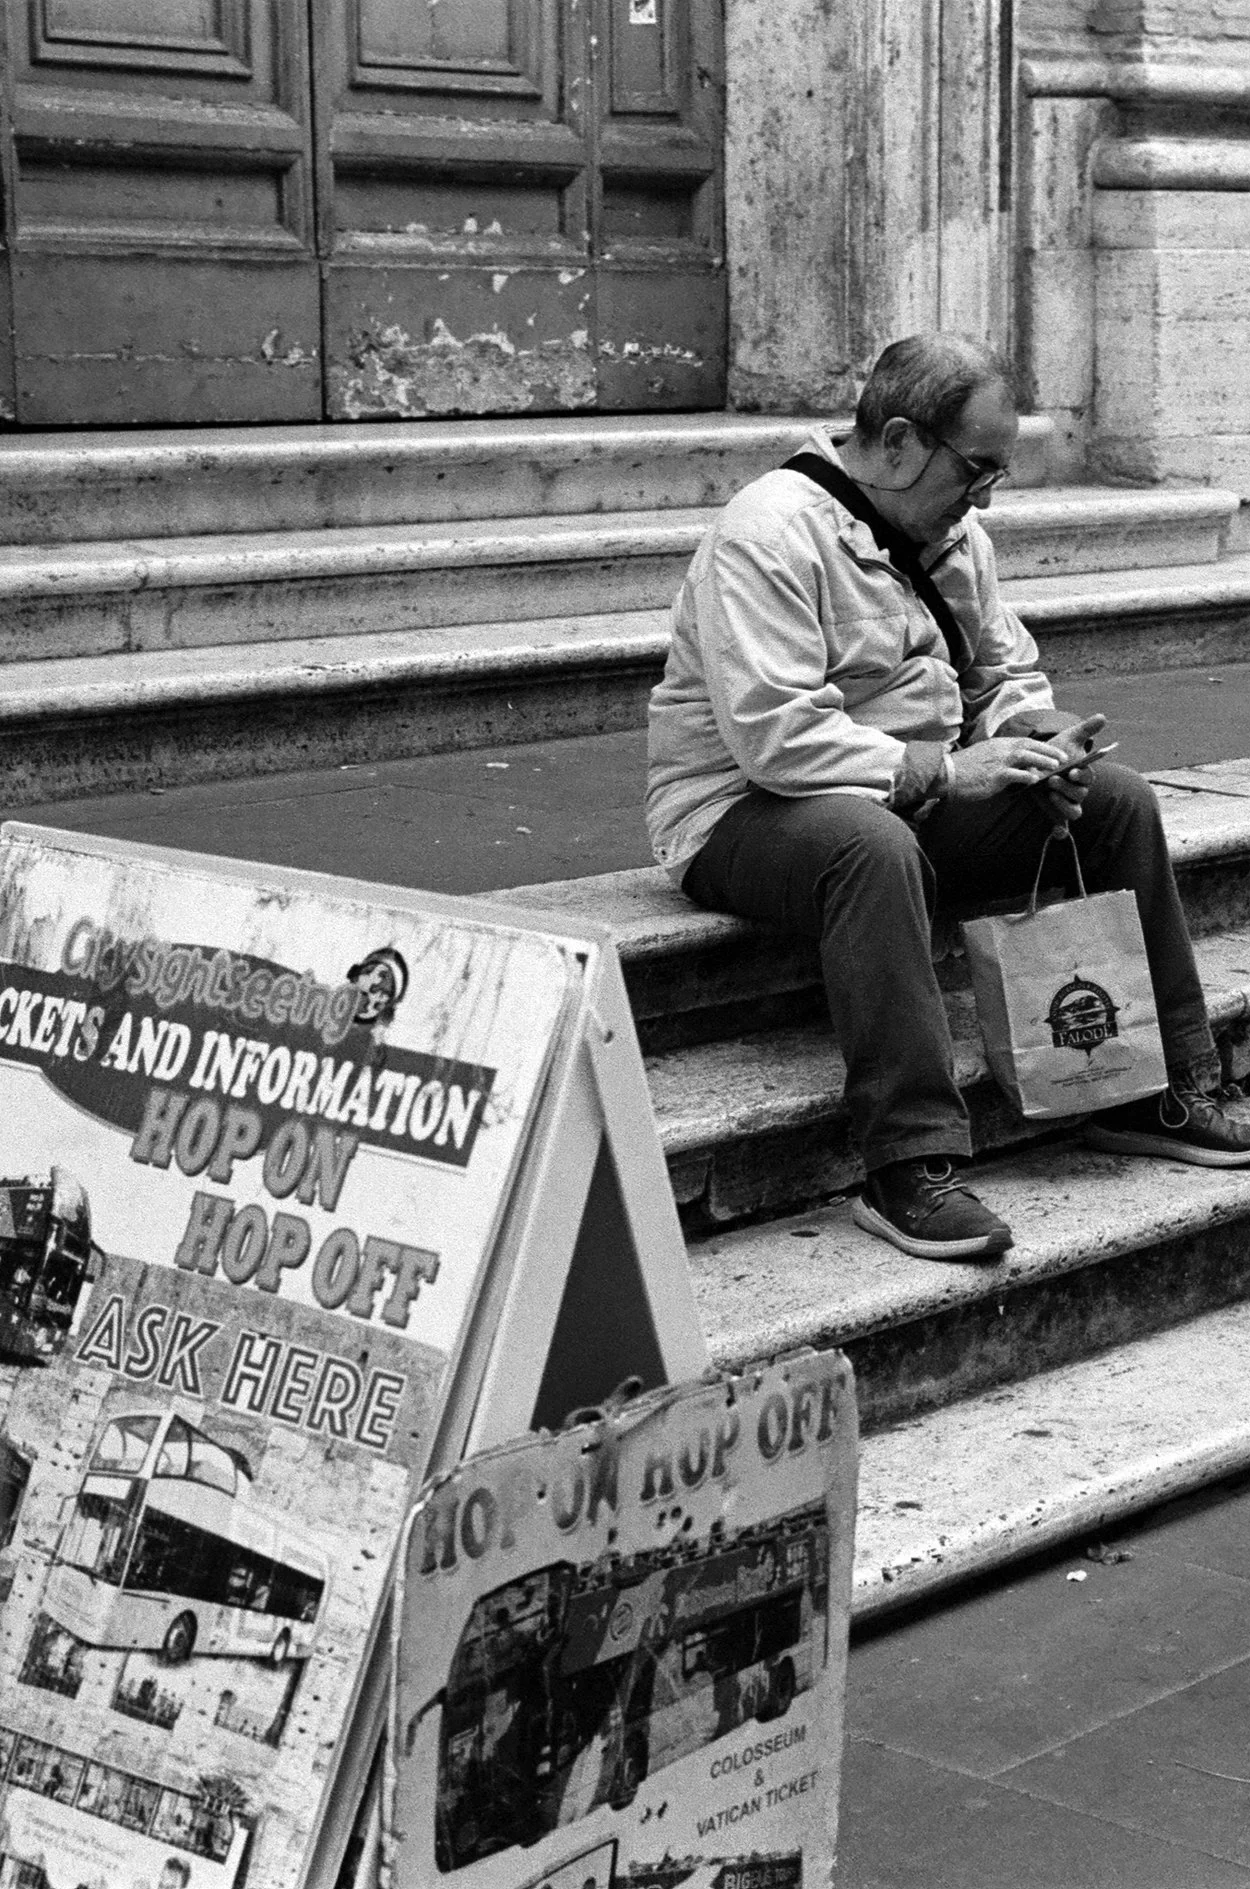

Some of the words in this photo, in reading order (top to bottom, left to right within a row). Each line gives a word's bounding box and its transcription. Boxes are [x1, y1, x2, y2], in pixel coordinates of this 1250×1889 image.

[0, 986, 105, 1061] CKETS
[100, 1012, 191, 1081] AND
[189, 1030, 482, 1149] INFORMATION
[130, 1087, 262, 1184] HOP
[261, 1117, 359, 1212] ON
[174, 1190, 312, 1293] HOP
[311, 1226, 441, 1329] OFF
[75, 1294, 225, 1397] ASK
[220, 1327, 407, 1452] HERE
[640, 1414, 742, 1502] HOP
[757, 1371, 850, 1460] OFF
[696, 1796, 762, 1838] VATICAN
[765, 1770, 819, 1808] TICKET
[709, 1724, 807, 1780] COLOSSEUM
[753, 1767, 766, 1787] &
